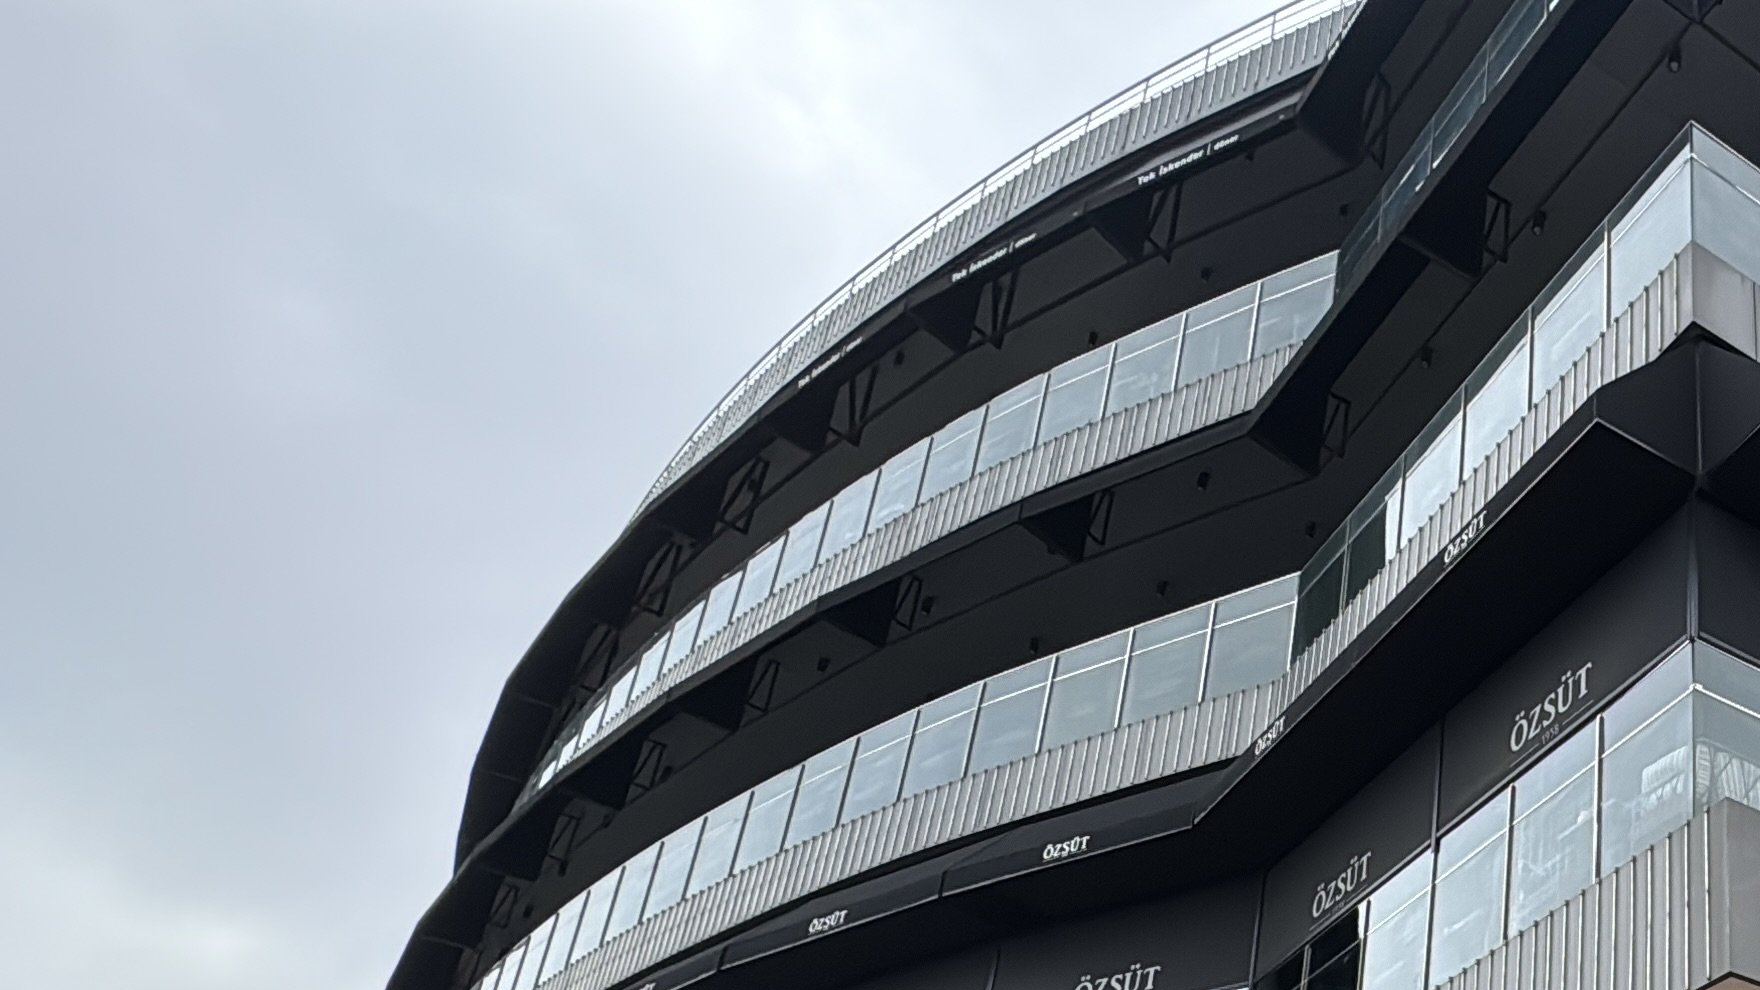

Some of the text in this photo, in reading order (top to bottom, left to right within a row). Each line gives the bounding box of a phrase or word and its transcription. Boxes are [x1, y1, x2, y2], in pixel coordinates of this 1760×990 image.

[1443, 510, 1487, 564] ÖZSÜT
[1510, 661, 1593, 752] ÖZSÜT
[1255, 716, 1286, 755] ÖZSÜT
[1042, 835, 1090, 861] ÖZSÜT
[1312, 851, 1372, 919] ÖZSÜT
[808, 909, 849, 935] ÖZSÜT
